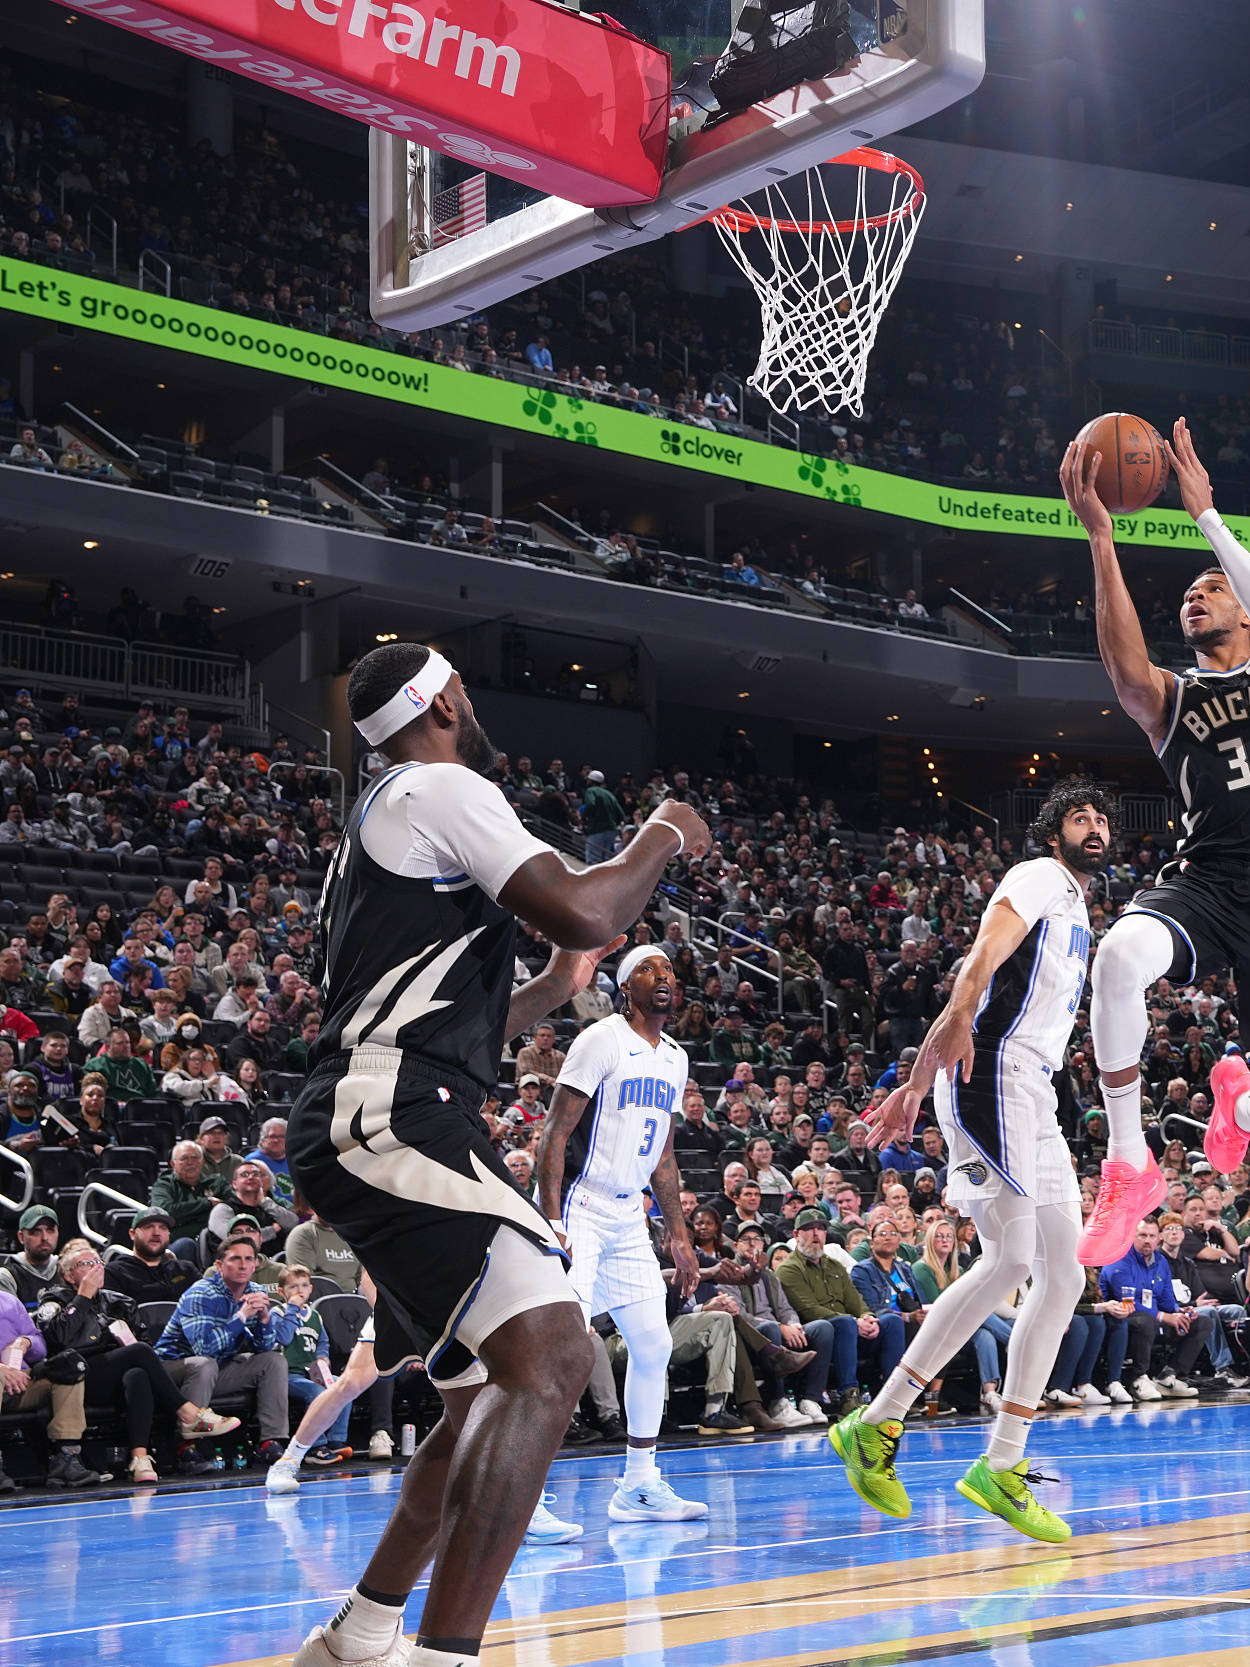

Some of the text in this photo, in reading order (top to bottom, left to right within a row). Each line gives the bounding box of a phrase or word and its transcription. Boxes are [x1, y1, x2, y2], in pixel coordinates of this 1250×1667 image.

[1, 269, 71, 306] Let's
[683, 437, 742, 466] clover
[938, 496, 1060, 526] Undefeated
[194, 559, 229, 578] 106
[638, 1117, 657, 1156] 3
